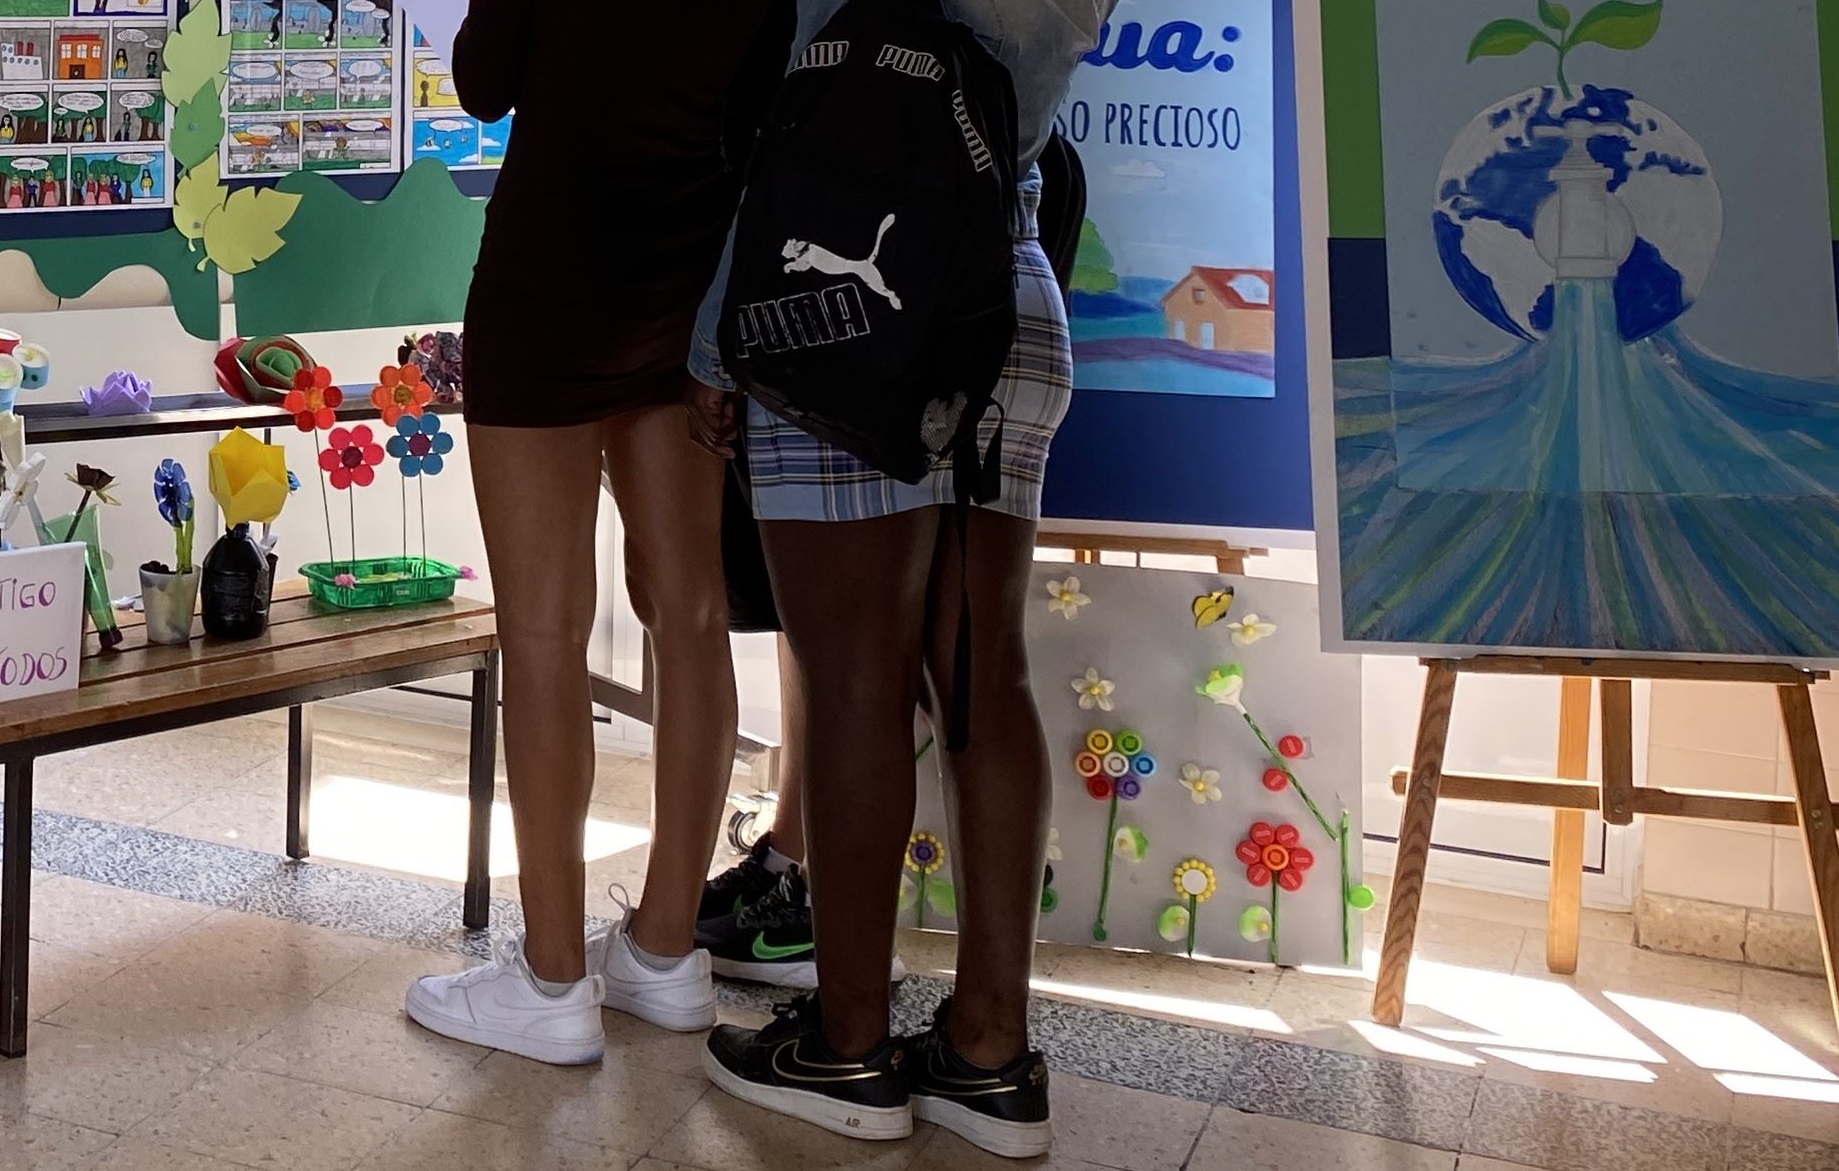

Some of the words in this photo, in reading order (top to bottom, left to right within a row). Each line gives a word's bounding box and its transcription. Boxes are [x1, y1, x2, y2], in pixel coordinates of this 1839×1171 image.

[876, 44, 946, 81] PUMA
[1080, 20, 1242, 73] ua:
[1104, 102, 1241, 151] PRECIOSO
[735, 282, 871, 359] PUMA
